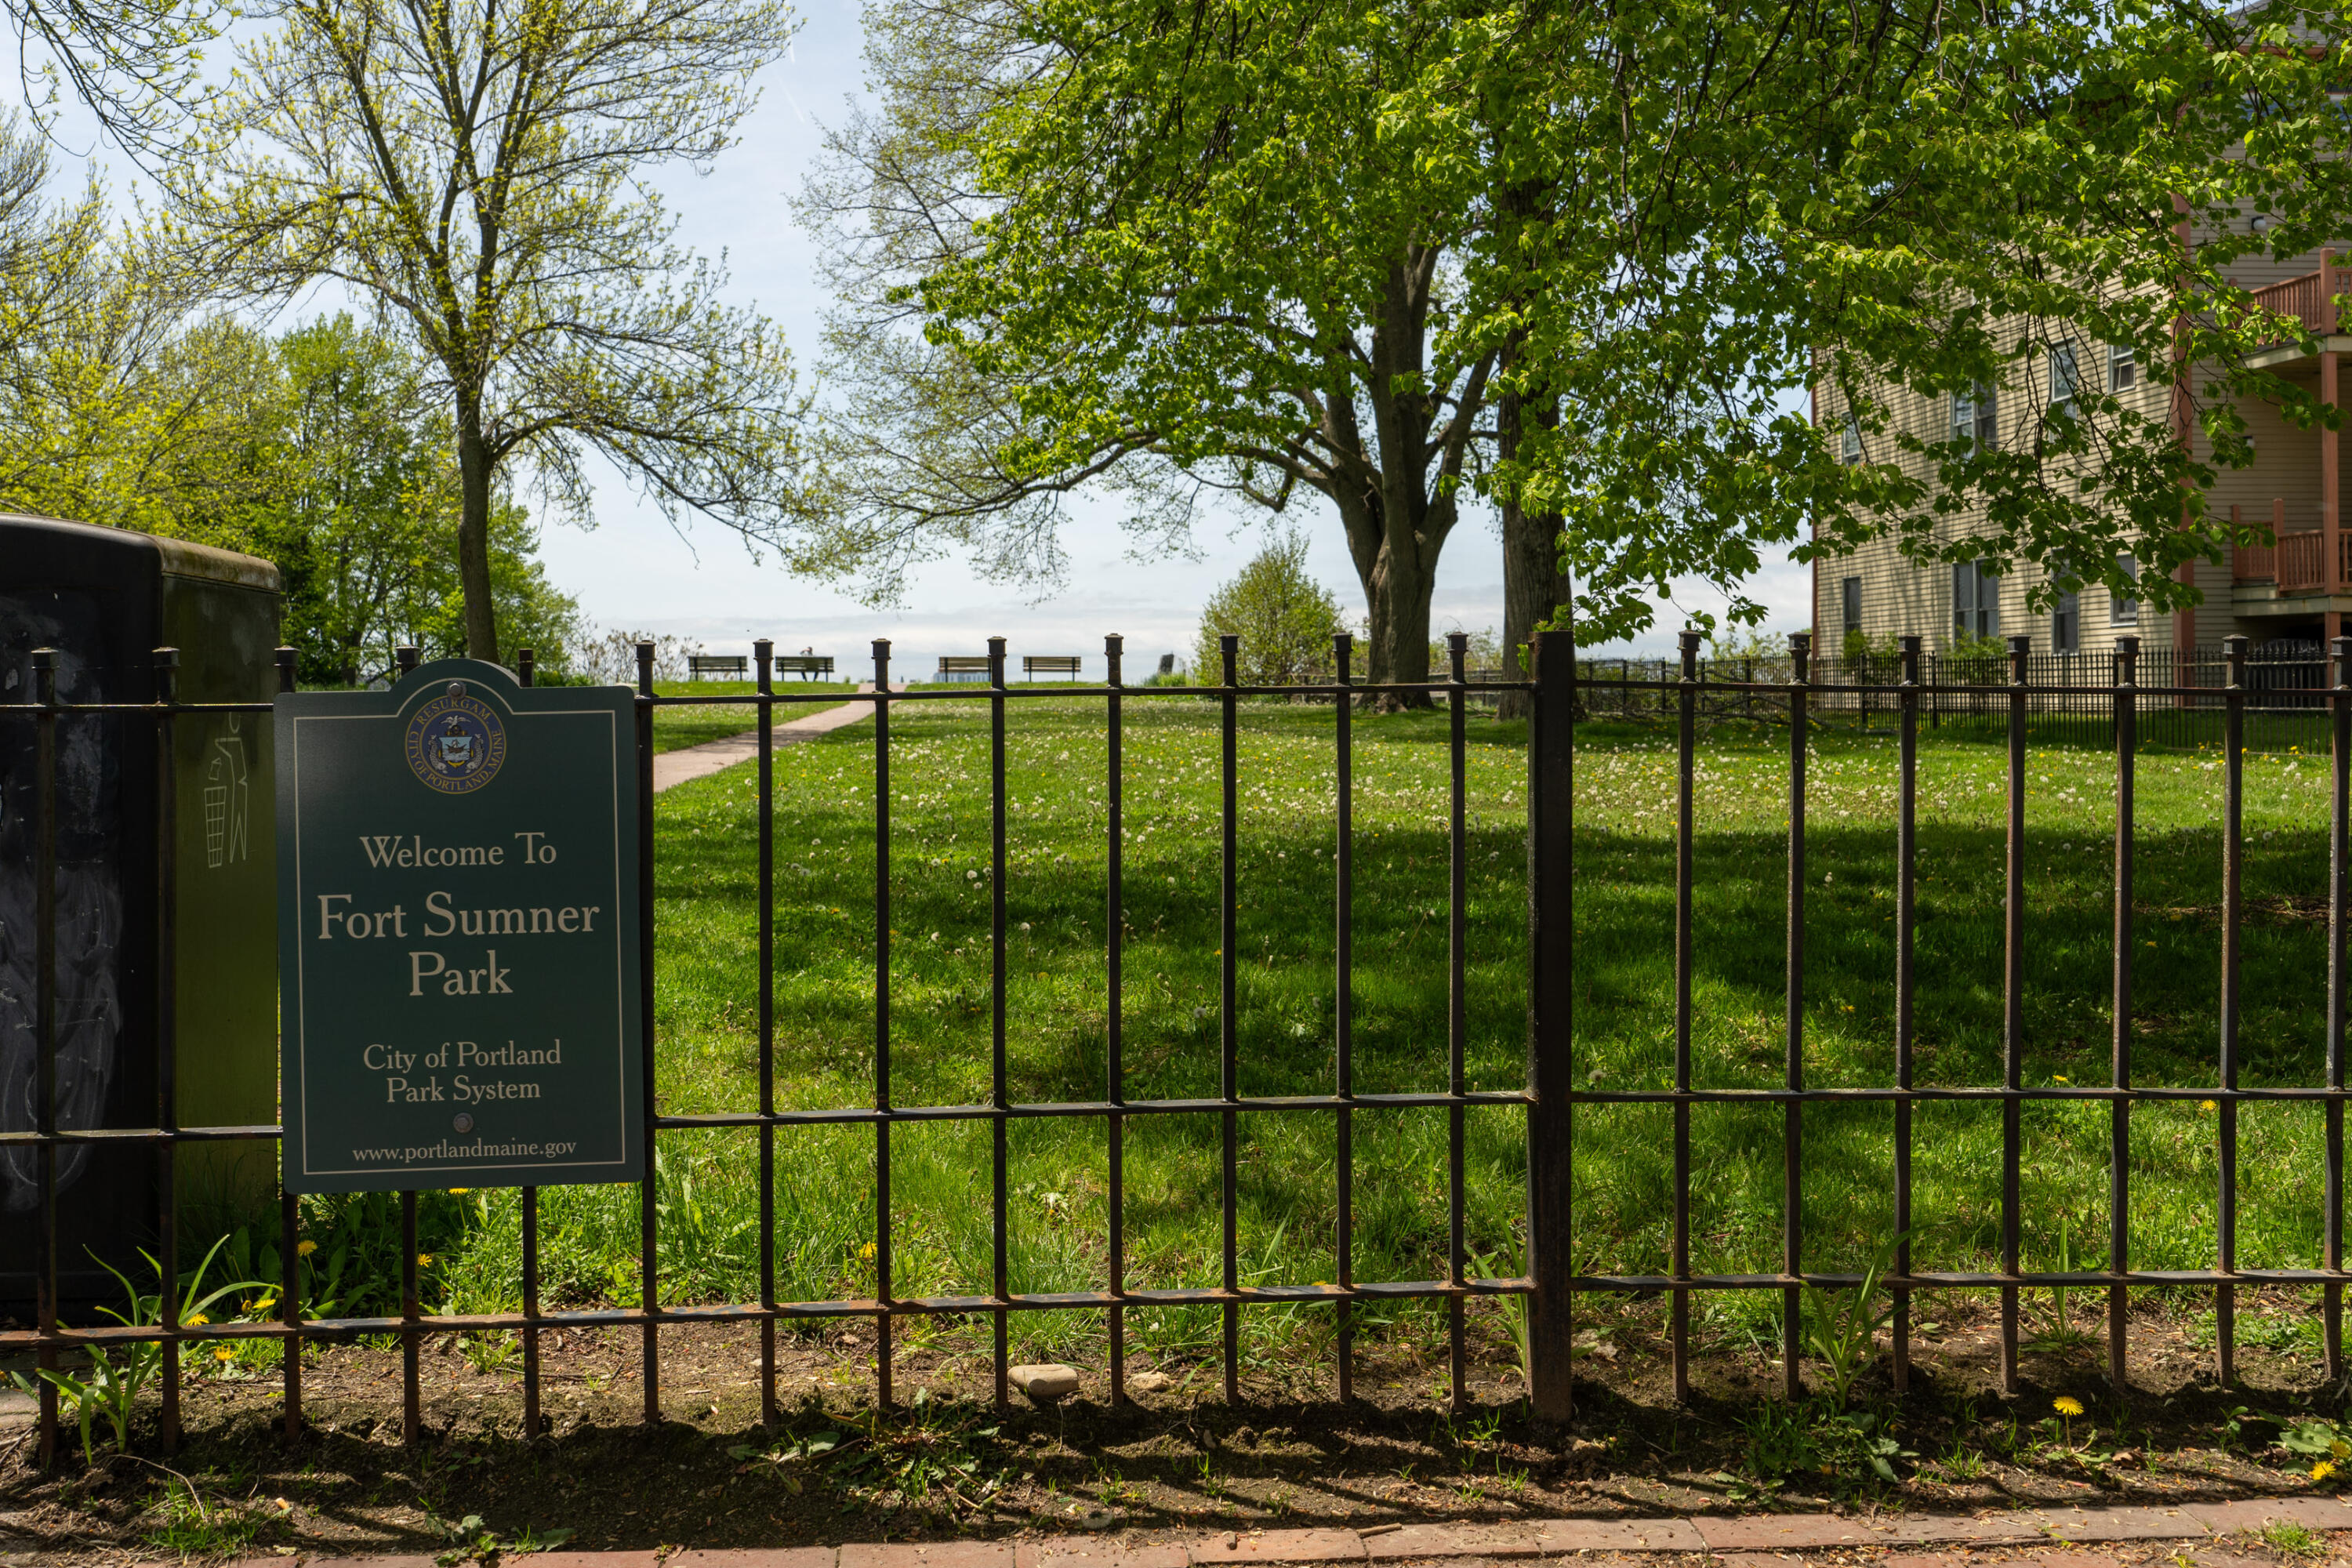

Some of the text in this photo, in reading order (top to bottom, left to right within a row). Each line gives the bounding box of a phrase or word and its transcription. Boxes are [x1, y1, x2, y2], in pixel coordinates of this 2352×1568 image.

[408, 728, 503, 791] CITY OF PORTLAND, MAINE
[360, 833, 557, 868] Welcome To
[318, 891, 600, 939] Fort Sumner
[409, 950, 514, 996] Park
[364, 1039, 561, 1074] City of Portland
[387, 1075, 541, 1105] Park System
[352, 1138, 577, 1163] www.portlandmaine.gov
